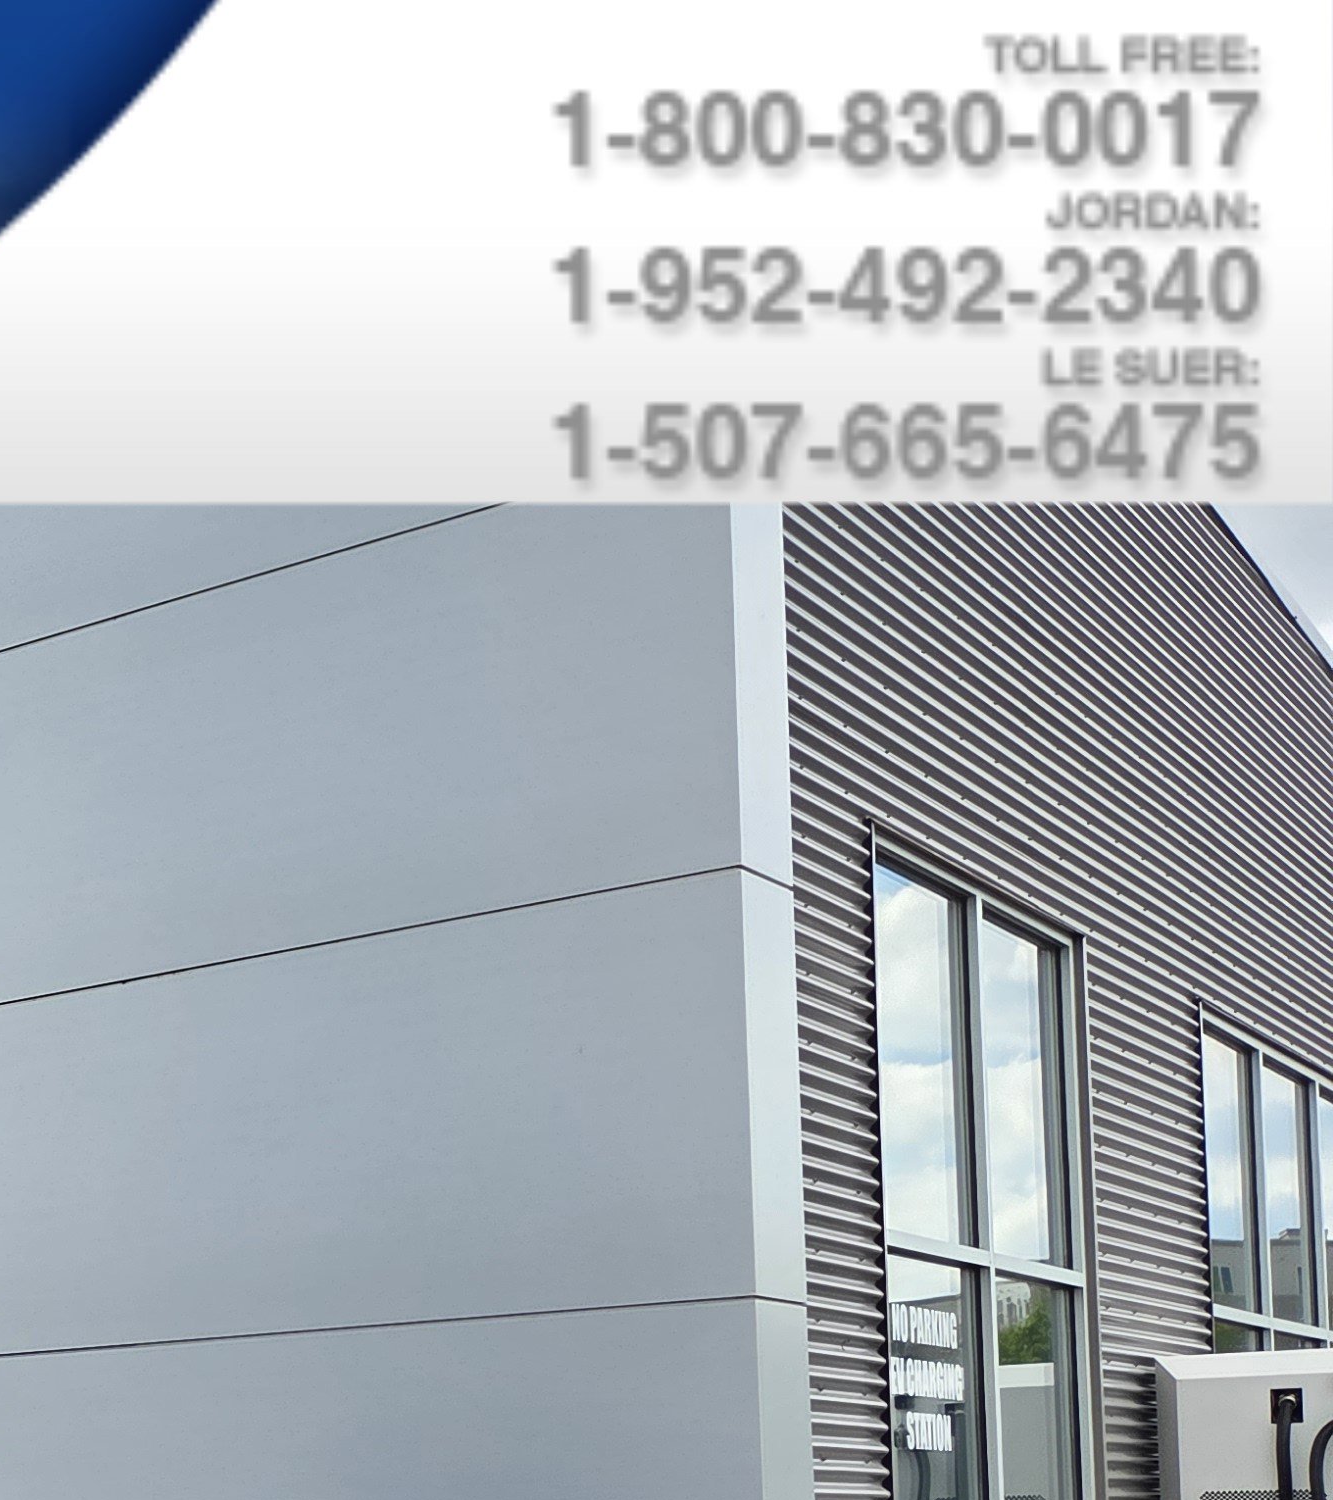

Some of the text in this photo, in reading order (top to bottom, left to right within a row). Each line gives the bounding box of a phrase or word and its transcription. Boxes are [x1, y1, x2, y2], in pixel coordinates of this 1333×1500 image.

[891, 1302, 959, 1350] NO PARKING
[890, 1356, 965, 1401] EV CHARGING
[905, 1411, 953, 1452] STATION
